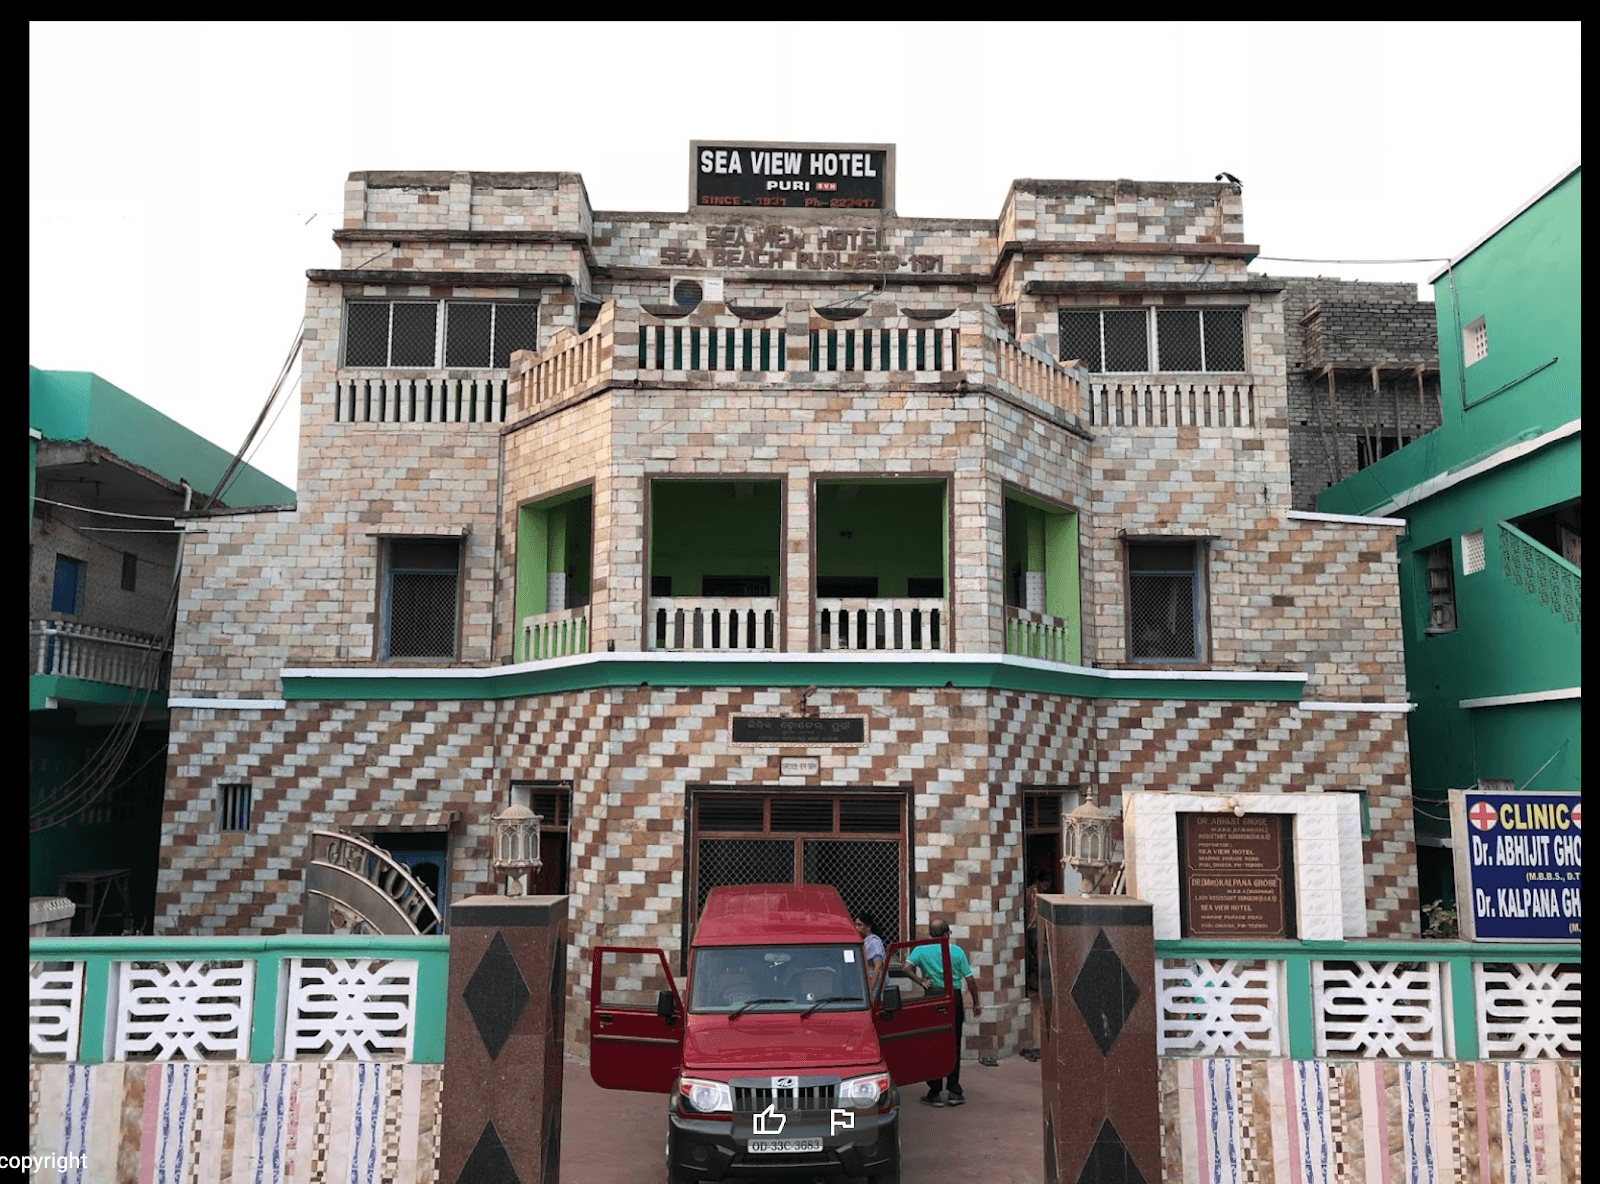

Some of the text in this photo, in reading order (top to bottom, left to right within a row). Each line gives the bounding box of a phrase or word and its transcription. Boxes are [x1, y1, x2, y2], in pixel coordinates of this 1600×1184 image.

[700, 150, 876, 177] SEA VIEW HOTEL
[766, 180, 810, 191] PURI
[701, 195, 741, 206] SINCE
[706, 226, 747, 248] SEA
[817, 230, 890, 252] HOTEL
[661, 247, 704, 266] SEA
[713, 248, 783, 268] BEACH
[1500, 803, 1571, 830] CLINIC
[1472, 835, 1493, 866] Dr.
[1496, 835, 1550, 867] ABHIJIT
[1219, 878, 1252, 887] KALPANA
[1253, 878, 1278, 887] GHOSE
[1230, 904, 1253, 912] HOTEL
[1476, 888, 1497, 918] Dr.
[1497, 888, 1561, 918] KALPANA
